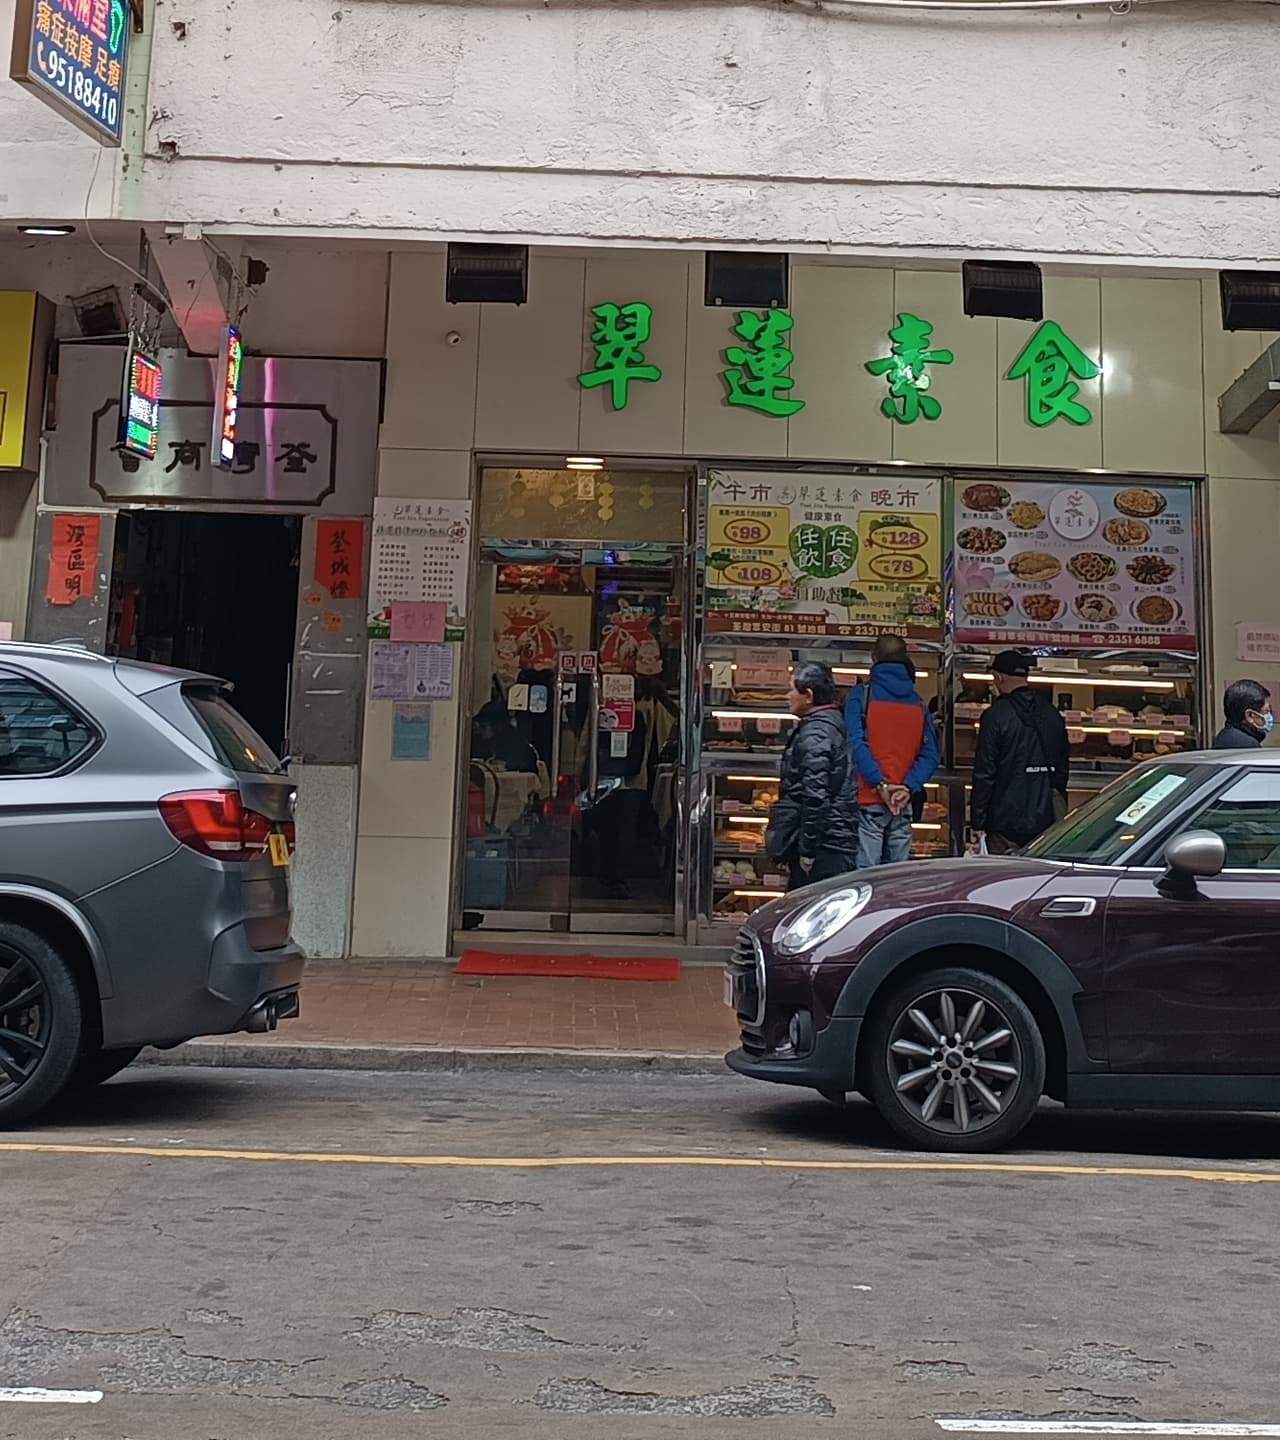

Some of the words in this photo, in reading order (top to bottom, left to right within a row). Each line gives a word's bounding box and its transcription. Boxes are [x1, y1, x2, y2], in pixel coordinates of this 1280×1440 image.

[47, 50, 117, 126] 95188410
[578, 301, 1102, 427] 翠蓮素食
[723, 482, 772, 502] 午市
[871, 489, 919, 507] 晚市
